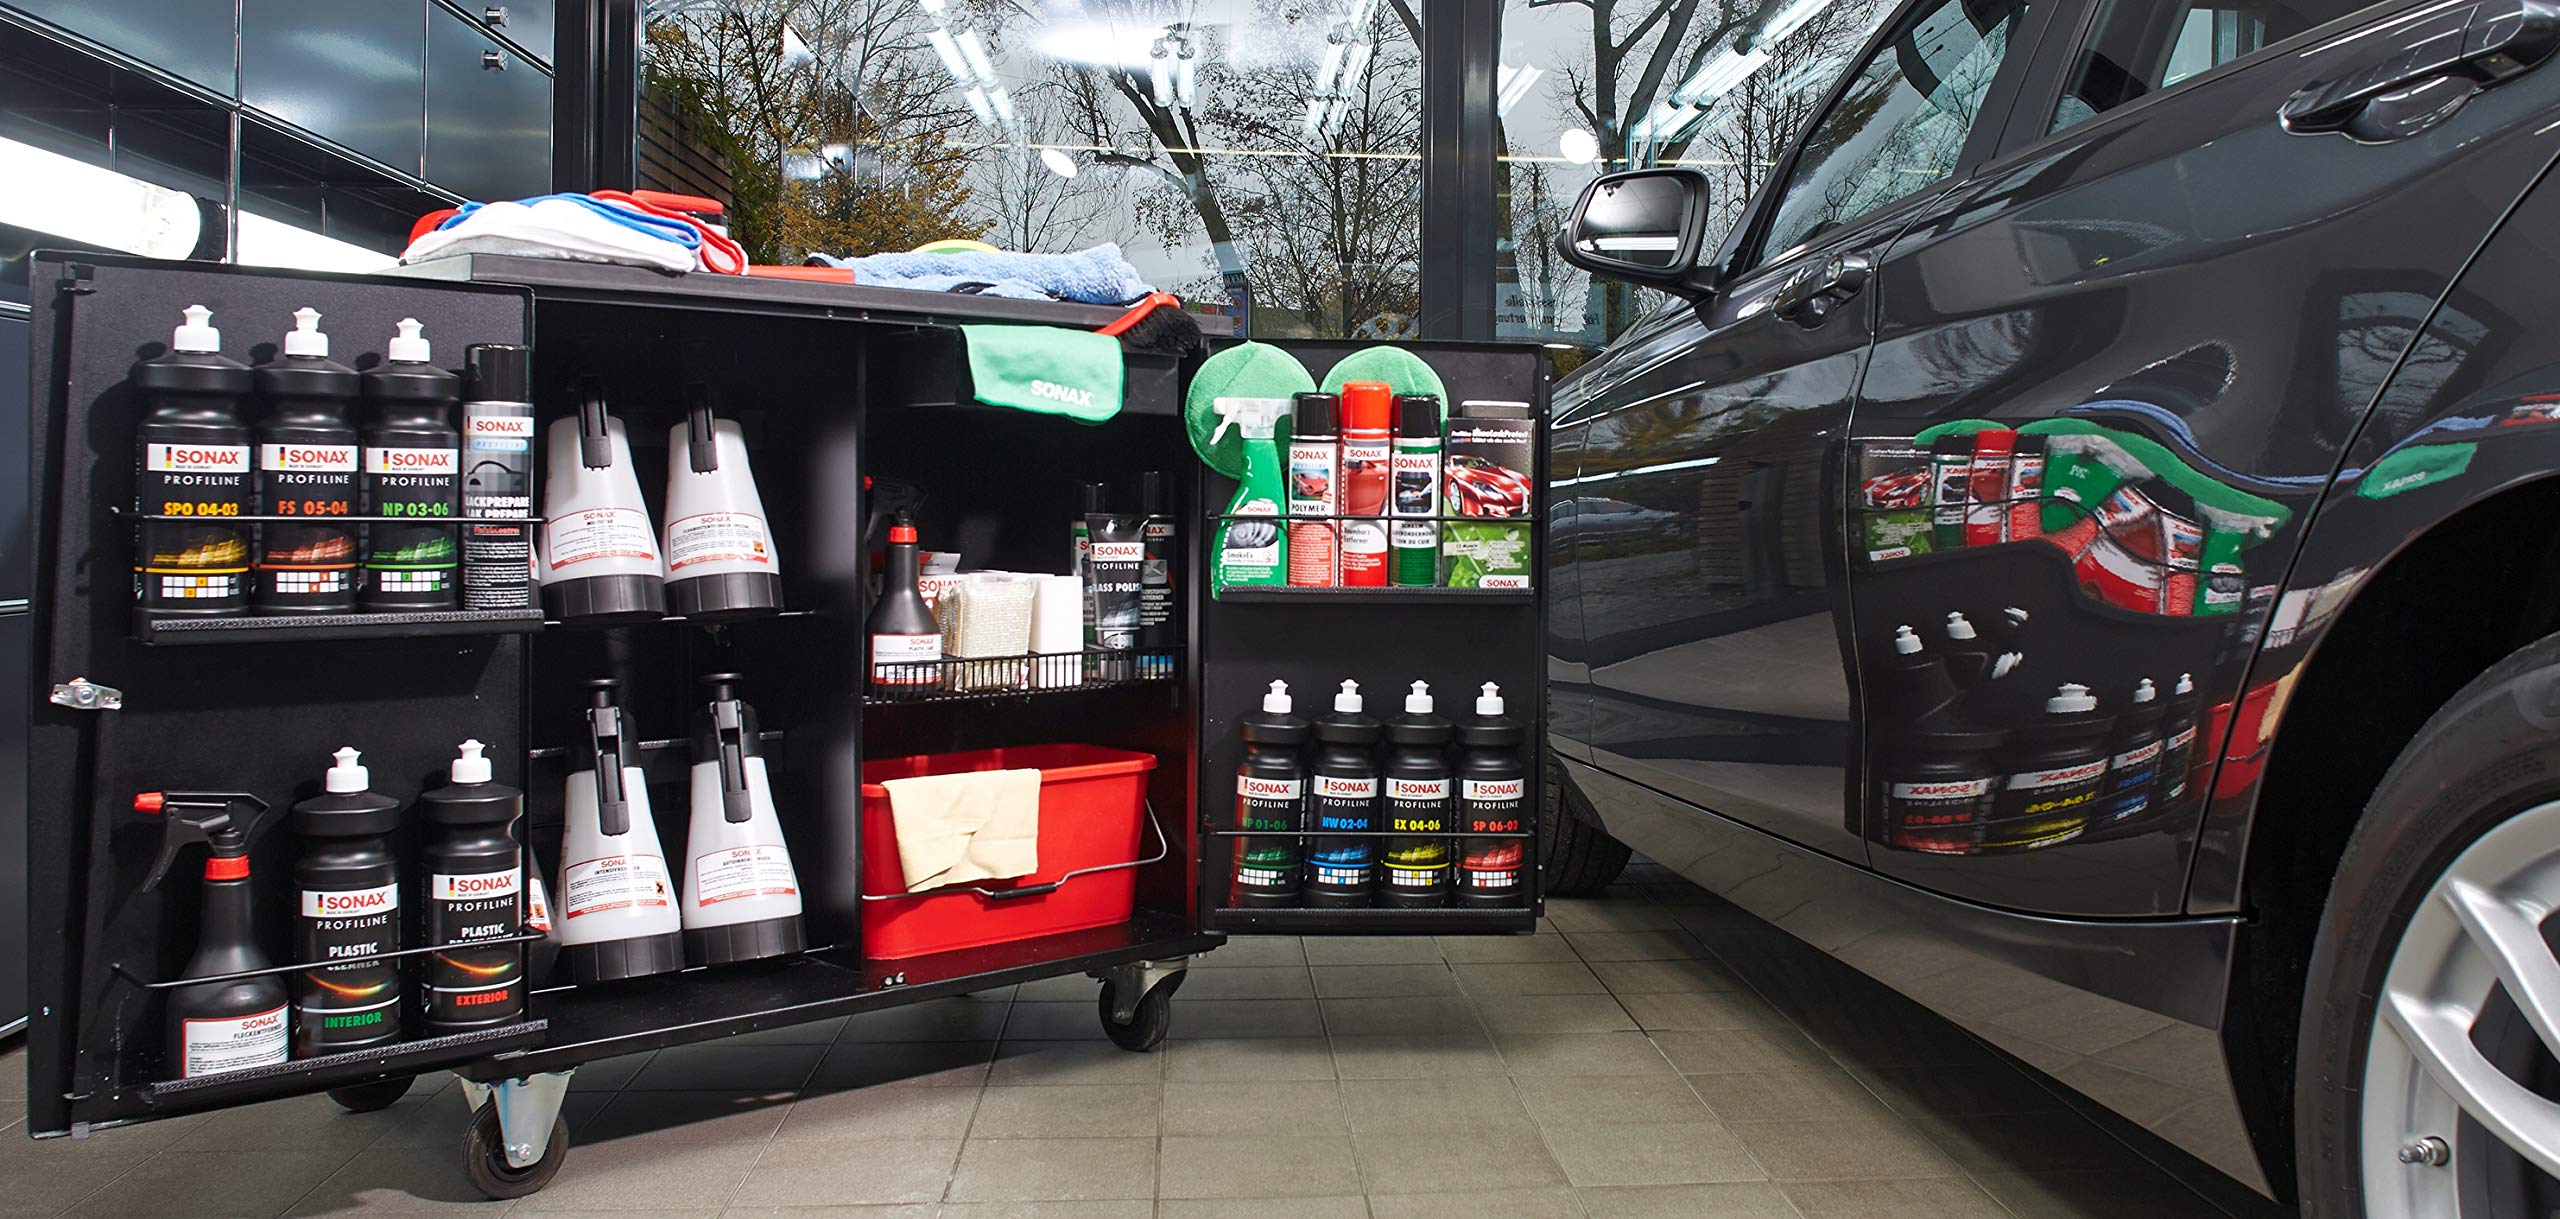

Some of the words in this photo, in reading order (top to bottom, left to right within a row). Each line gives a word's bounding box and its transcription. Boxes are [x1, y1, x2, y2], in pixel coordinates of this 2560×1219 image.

[1030, 379, 1095, 407] SONAX
[476, 421, 524, 432] SONAX
[175, 450, 239, 464] SONAX
[289, 450, 348, 463] SONAX
[392, 453, 449, 466] SONAX
[1293, 450, 1328, 460] SONAX
[1350, 449, 1382, 458] SONAX
[1394, 458, 1433, 468] SONAX
[164, 475, 240, 486] PROFILINE
[278, 474, 350, 484] PROFILINE
[382, 476, 450, 487] PROFILINE
[164, 502, 193, 516] SPO
[197, 503, 239, 516] 04-03
[278, 501, 296, 515] FS
[303, 501, 348, 515] 05-04
[383, 503, 404, 516] NP
[406, 503, 449, 516] 03-06
[1097, 546, 1138, 555] SONAX
[1115, 583, 1142, 592] POLIS
[1487, 579, 1519, 587] SONAX
[1249, 781, 1289, 794] SONAX
[1330, 781, 1370, 792] SONAX
[1400, 783, 1441, 794] SONAX
[1480, 783, 1518, 795] SONAX
[1242, 798, 1289, 809] PROFILINE
[1323, 798, 1369, 807] PROFILINE
[1394, 800, 1441, 808] PROFILINE
[1473, 800, 1519, 809] PROFILINE
[1255, 818, 1288, 831] 01-06
[1322, 817, 1339, 828] HW
[1340, 818, 1368, 830] 02-04
[1394, 819, 1407, 830] EX
[1409, 820, 1441, 831] 04-06
[1473, 820, 1486, 831] SP
[732, 848, 762, 858] SONX
[601, 858, 628, 868] SONA
[457, 874, 512, 892] SONAX
[327, 892, 386, 910] SONAX
[448, 896, 514, 912] PROFILINE
[317, 915, 387, 930] PROFILINE
[461, 923, 504, 938] PLASTIC
[329, 942, 378, 958] PLASTIC
[455, 990, 508, 1007] EXTERIOR
[242, 1014, 280, 1030] SONAX
[325, 1011, 382, 1028] INTERIOR
